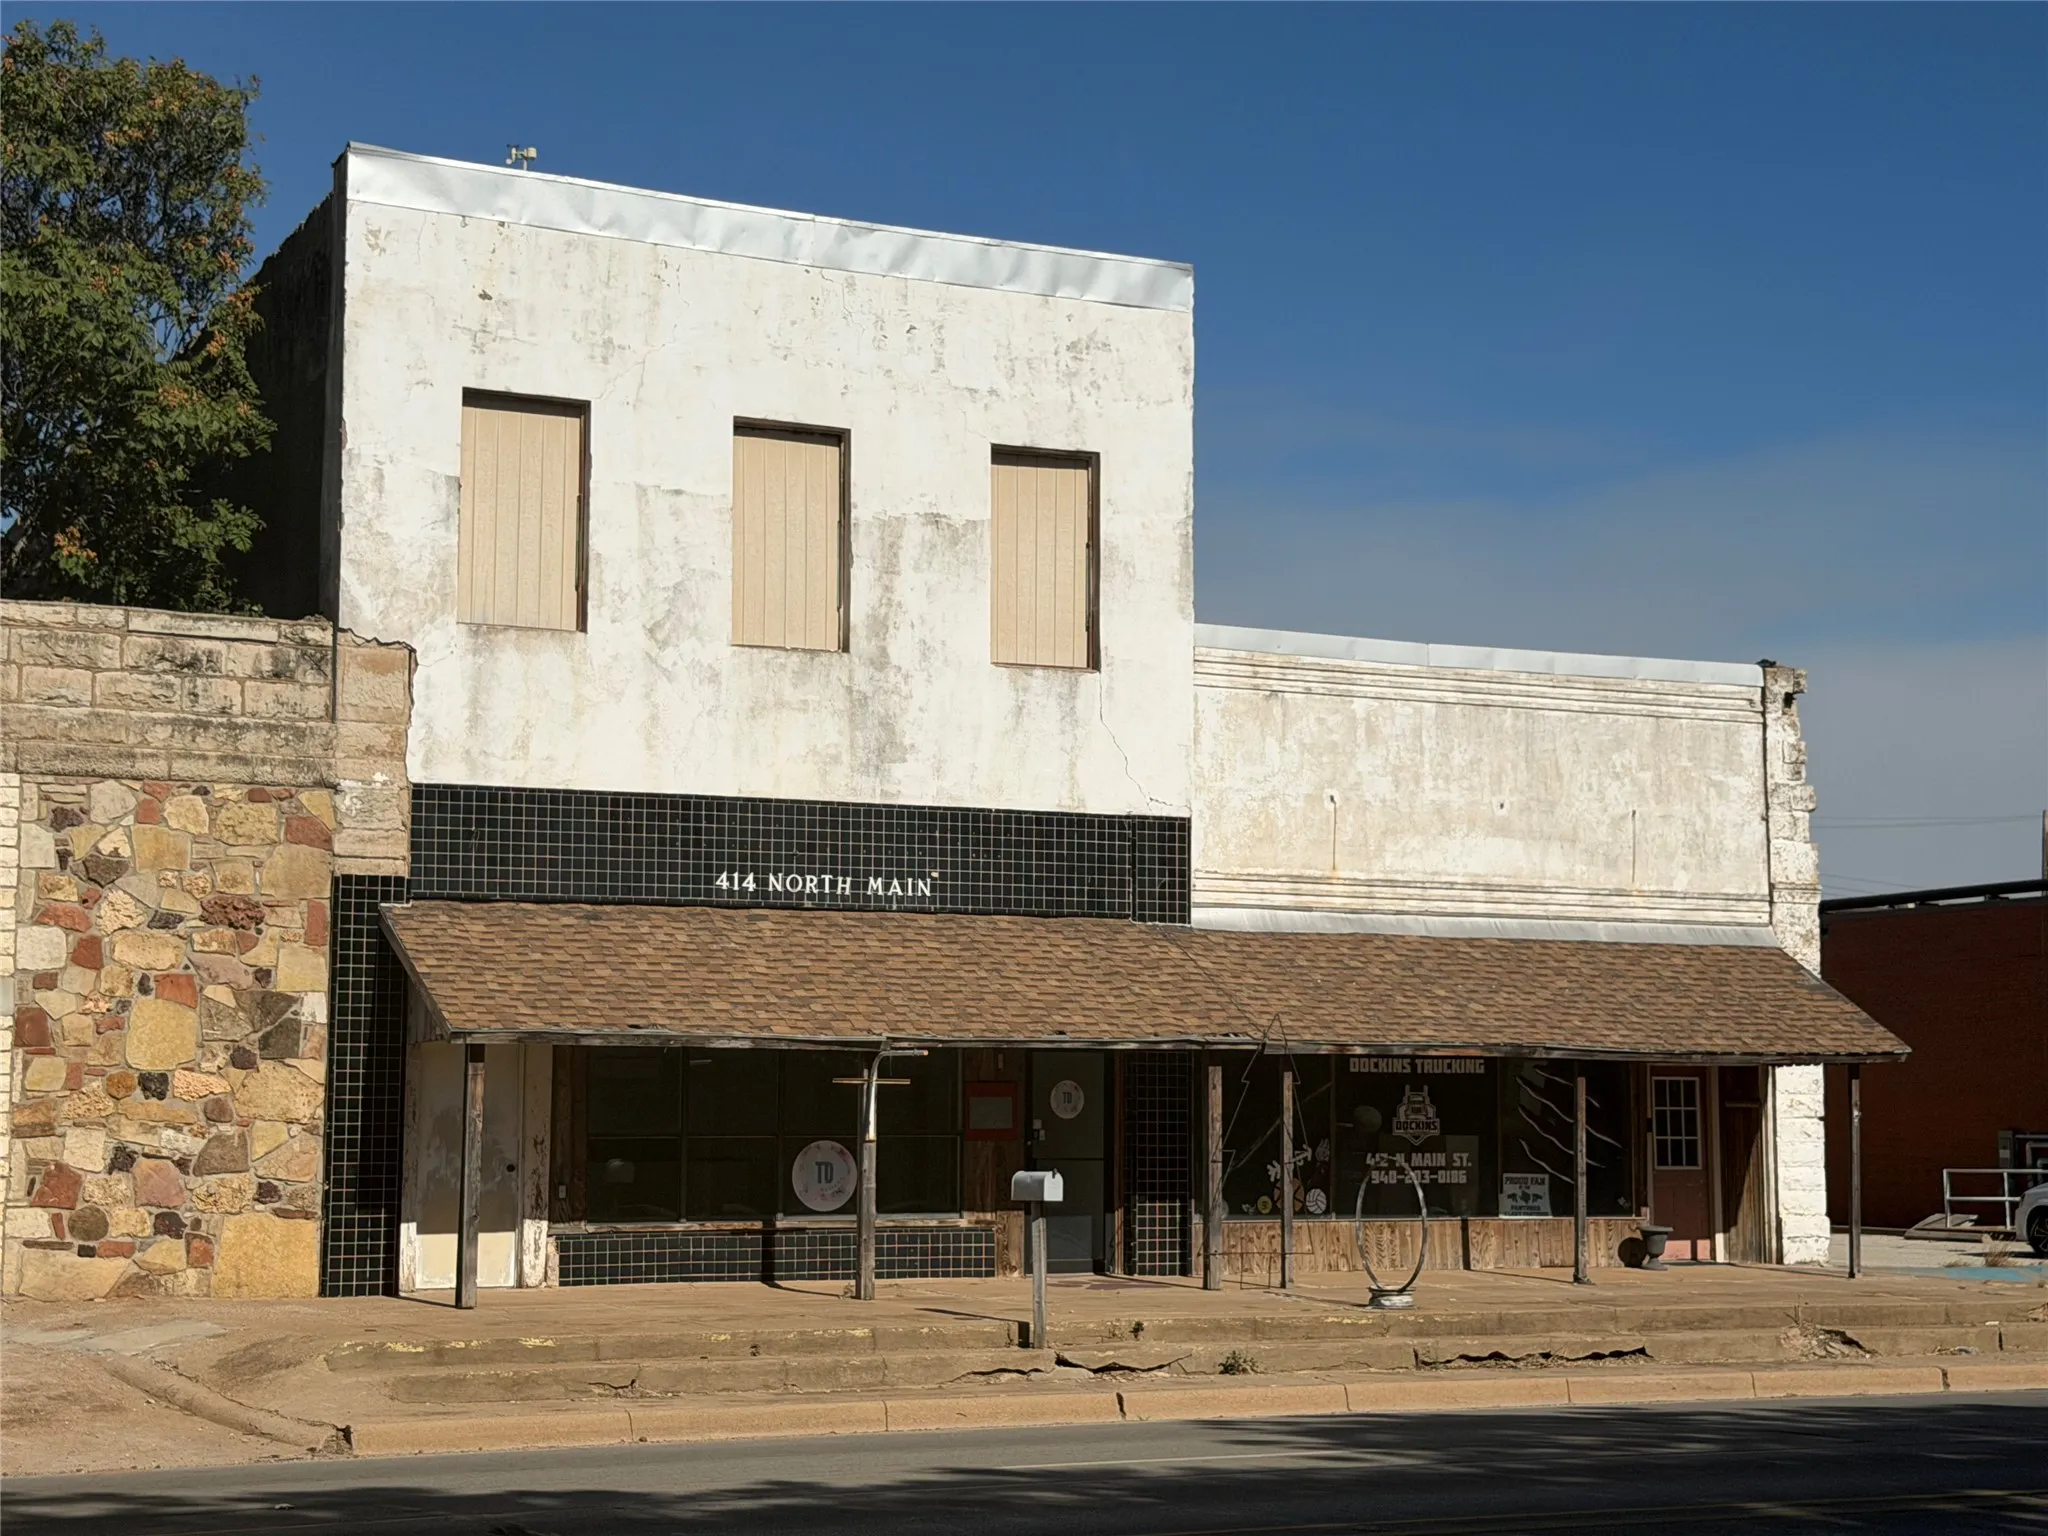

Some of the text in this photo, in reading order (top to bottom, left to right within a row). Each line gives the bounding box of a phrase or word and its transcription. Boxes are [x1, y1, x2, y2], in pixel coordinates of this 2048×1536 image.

[715, 871, 932, 896] 414 NORTH MAIN
[1349, 1057, 1485, 1074] DOCKINS TRUCKING
[1395, 1120, 1438, 1131] DOCKINS
[1395, 1152, 1405, 1168] N
[1411, 1152, 1446, 1167] MAIN
[1452, 1152, 1472, 1167] ST.
[815, 1161, 834, 1185] TD
